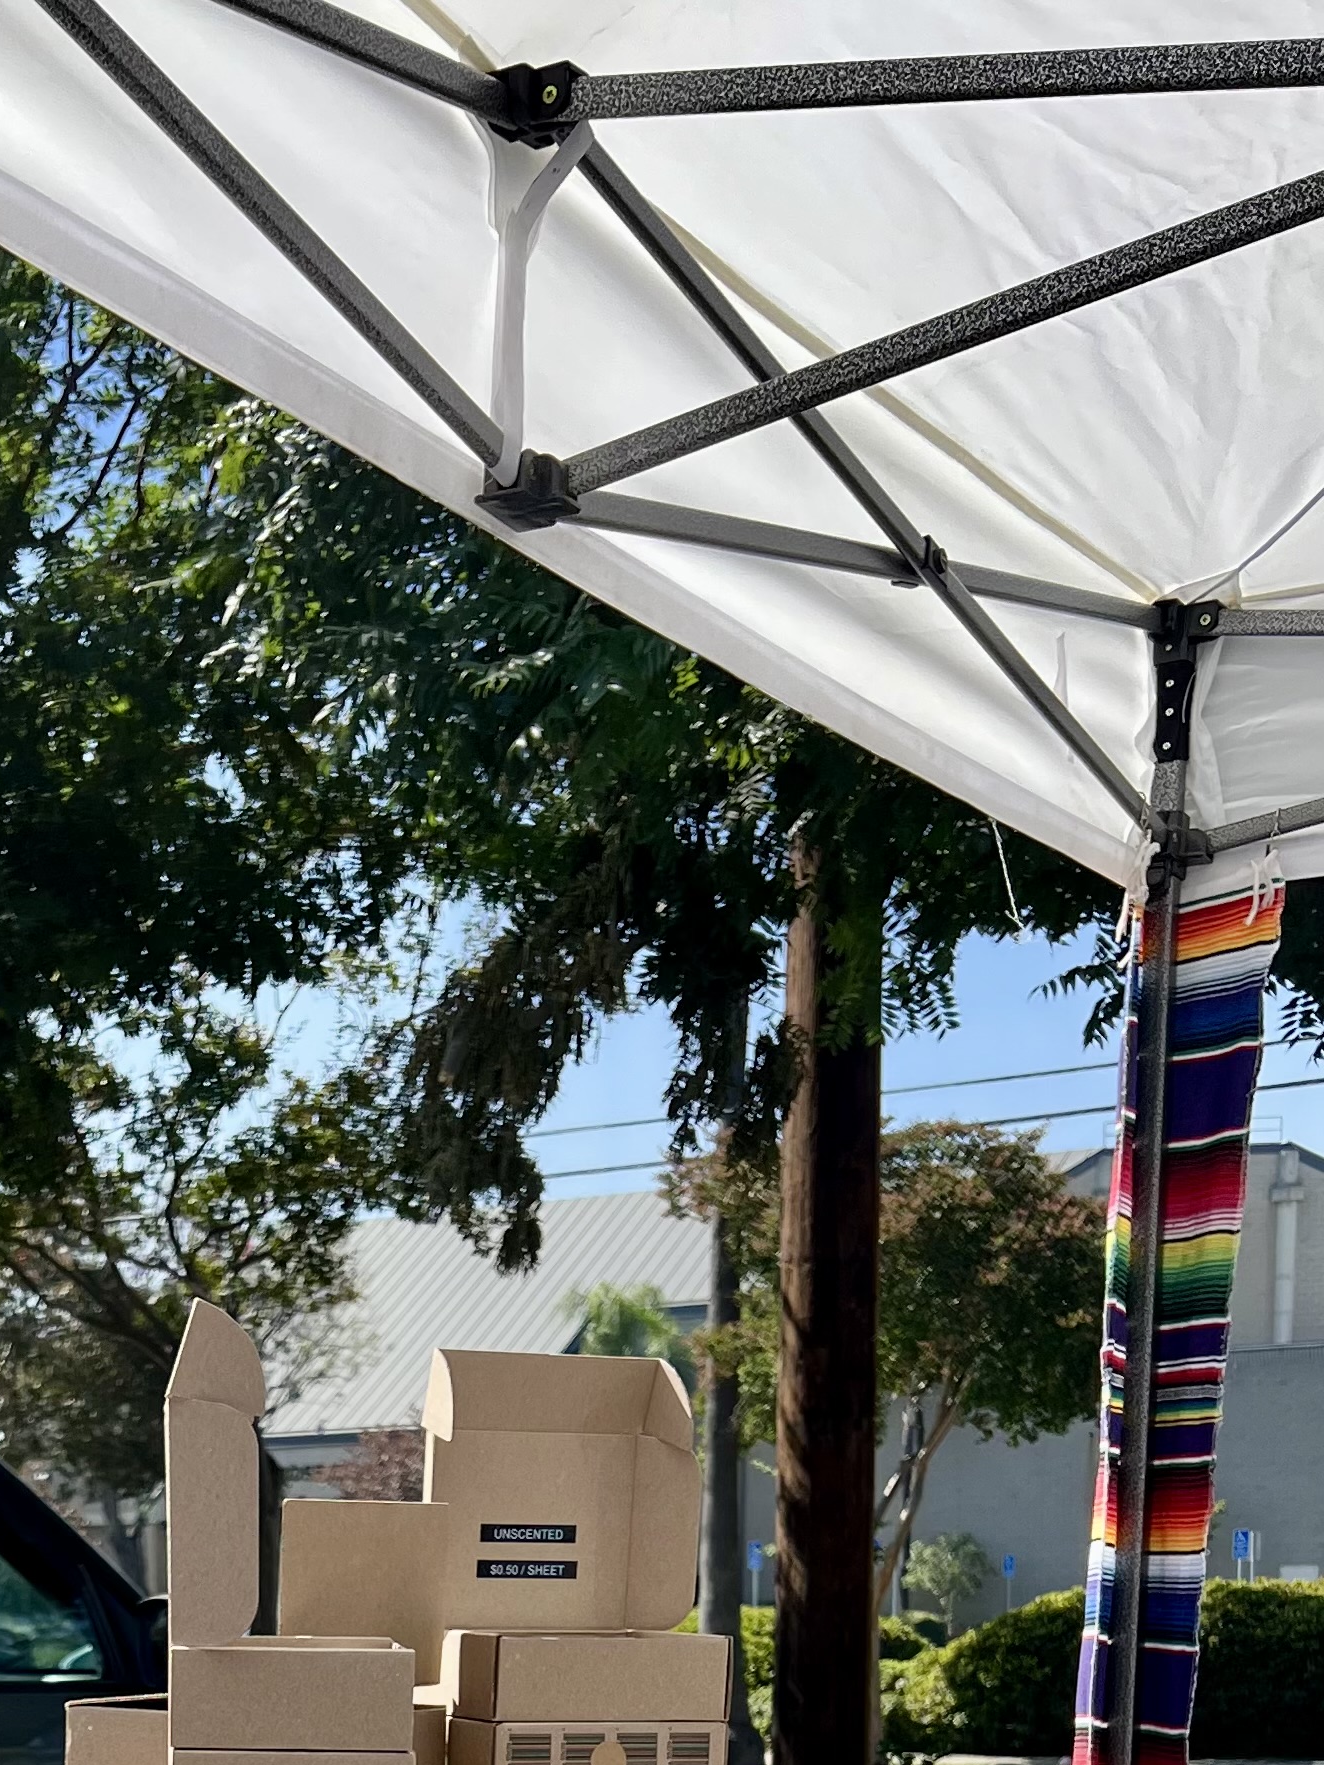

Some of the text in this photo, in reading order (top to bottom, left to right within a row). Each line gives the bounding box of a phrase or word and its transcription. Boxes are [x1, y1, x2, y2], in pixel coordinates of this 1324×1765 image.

[493, 1528, 564, 1540] UNSCENTED
[490, 1564, 518, 1576] $0.50
[527, 1564, 565, 1576] SHEET
